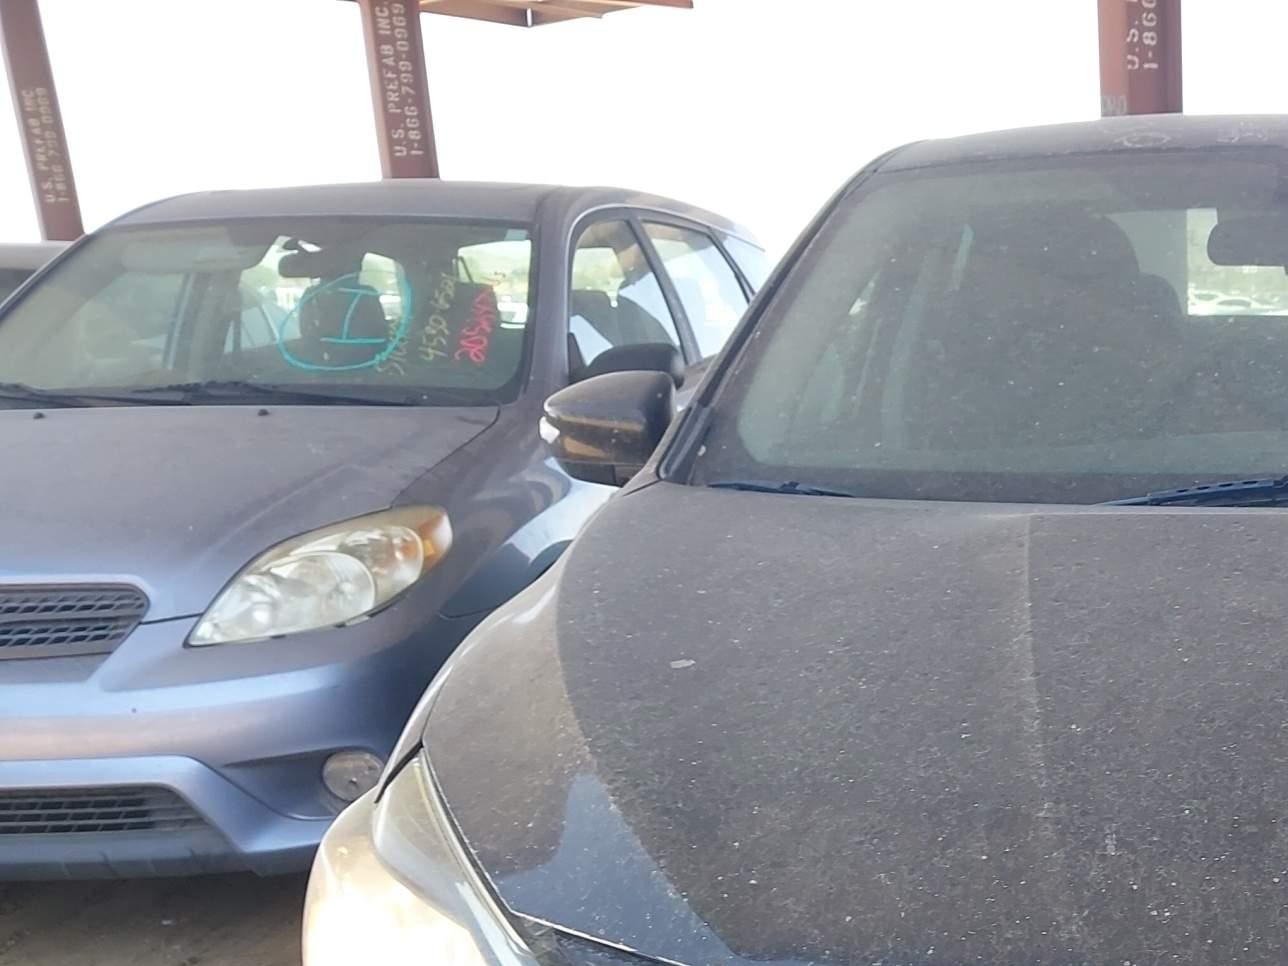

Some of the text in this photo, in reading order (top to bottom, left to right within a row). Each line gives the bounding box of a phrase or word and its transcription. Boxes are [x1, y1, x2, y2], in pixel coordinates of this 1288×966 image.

[1126, 20, 1140, 70] U.S.
[380, 44, 402, 113] PREFAB
[390, 3, 424, 156] 1-866-799-0969
[391, 124, 408, 157] U.S.
